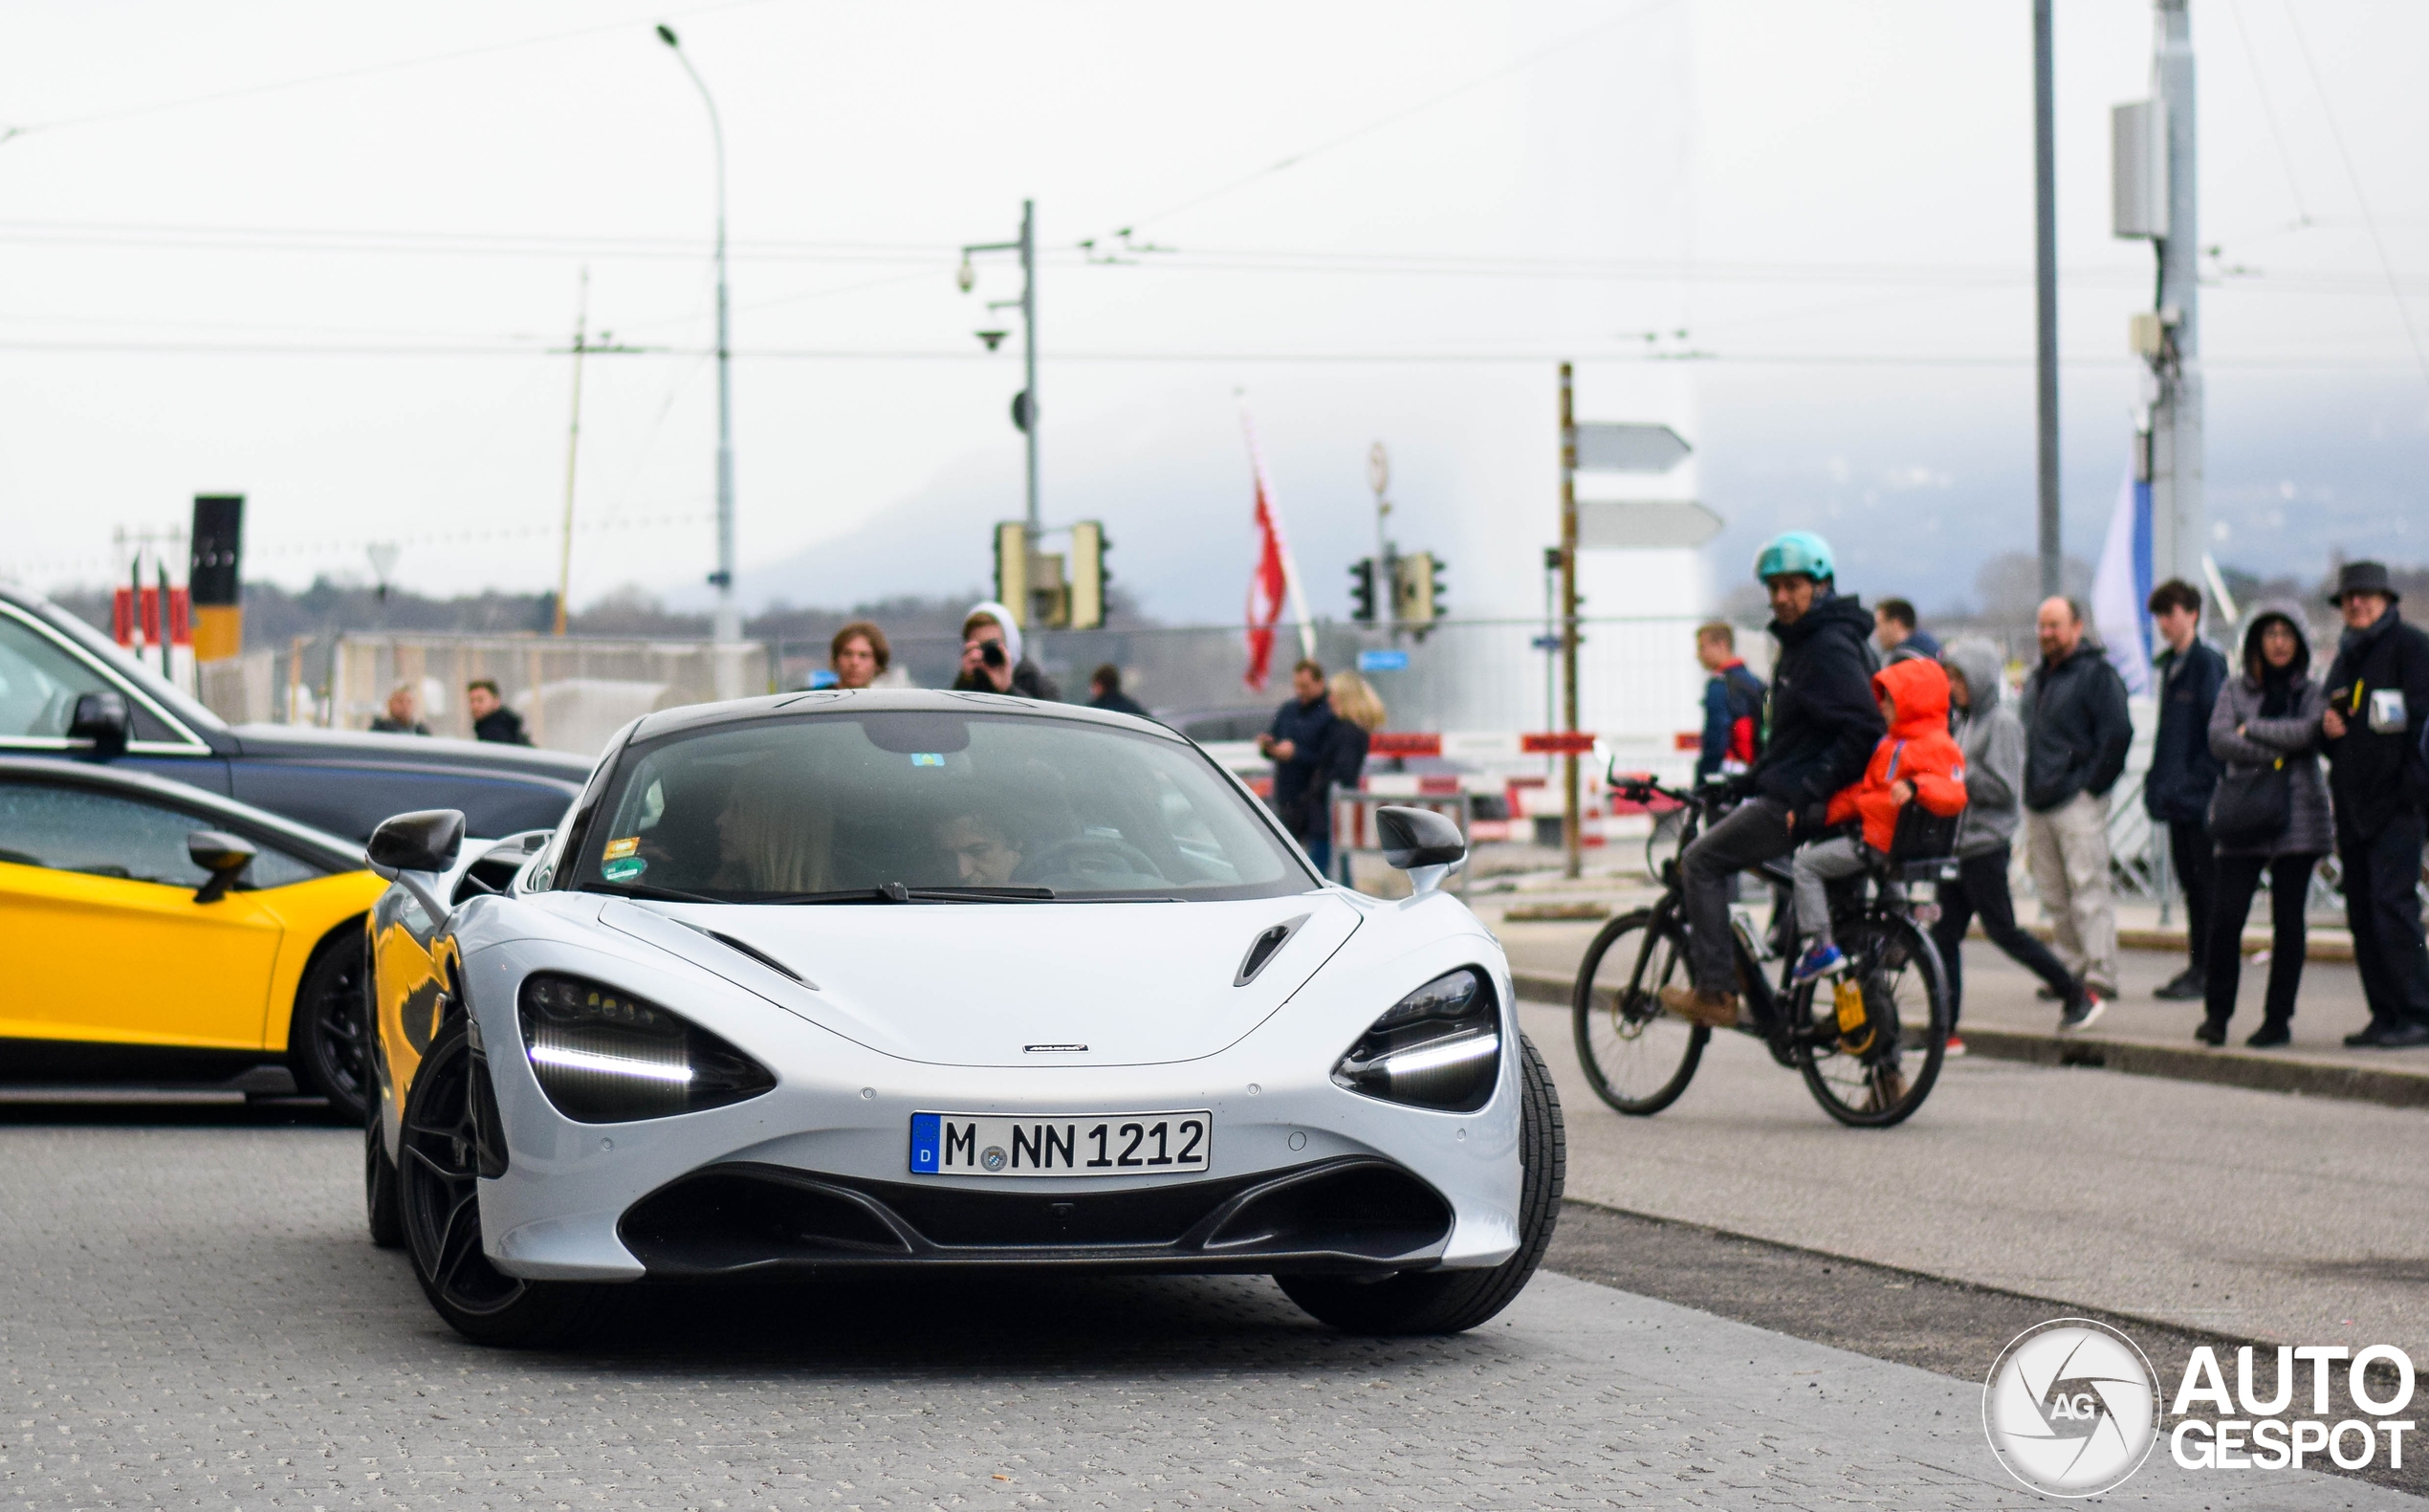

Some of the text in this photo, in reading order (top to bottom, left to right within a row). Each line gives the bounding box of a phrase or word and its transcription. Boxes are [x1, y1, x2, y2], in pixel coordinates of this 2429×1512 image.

[920, 1149, 931, 1162] D
[945, 1122, 976, 1166] M
[1012, 1124, 1076, 1168] NN
[1086, 1120, 1204, 1167] 1212
